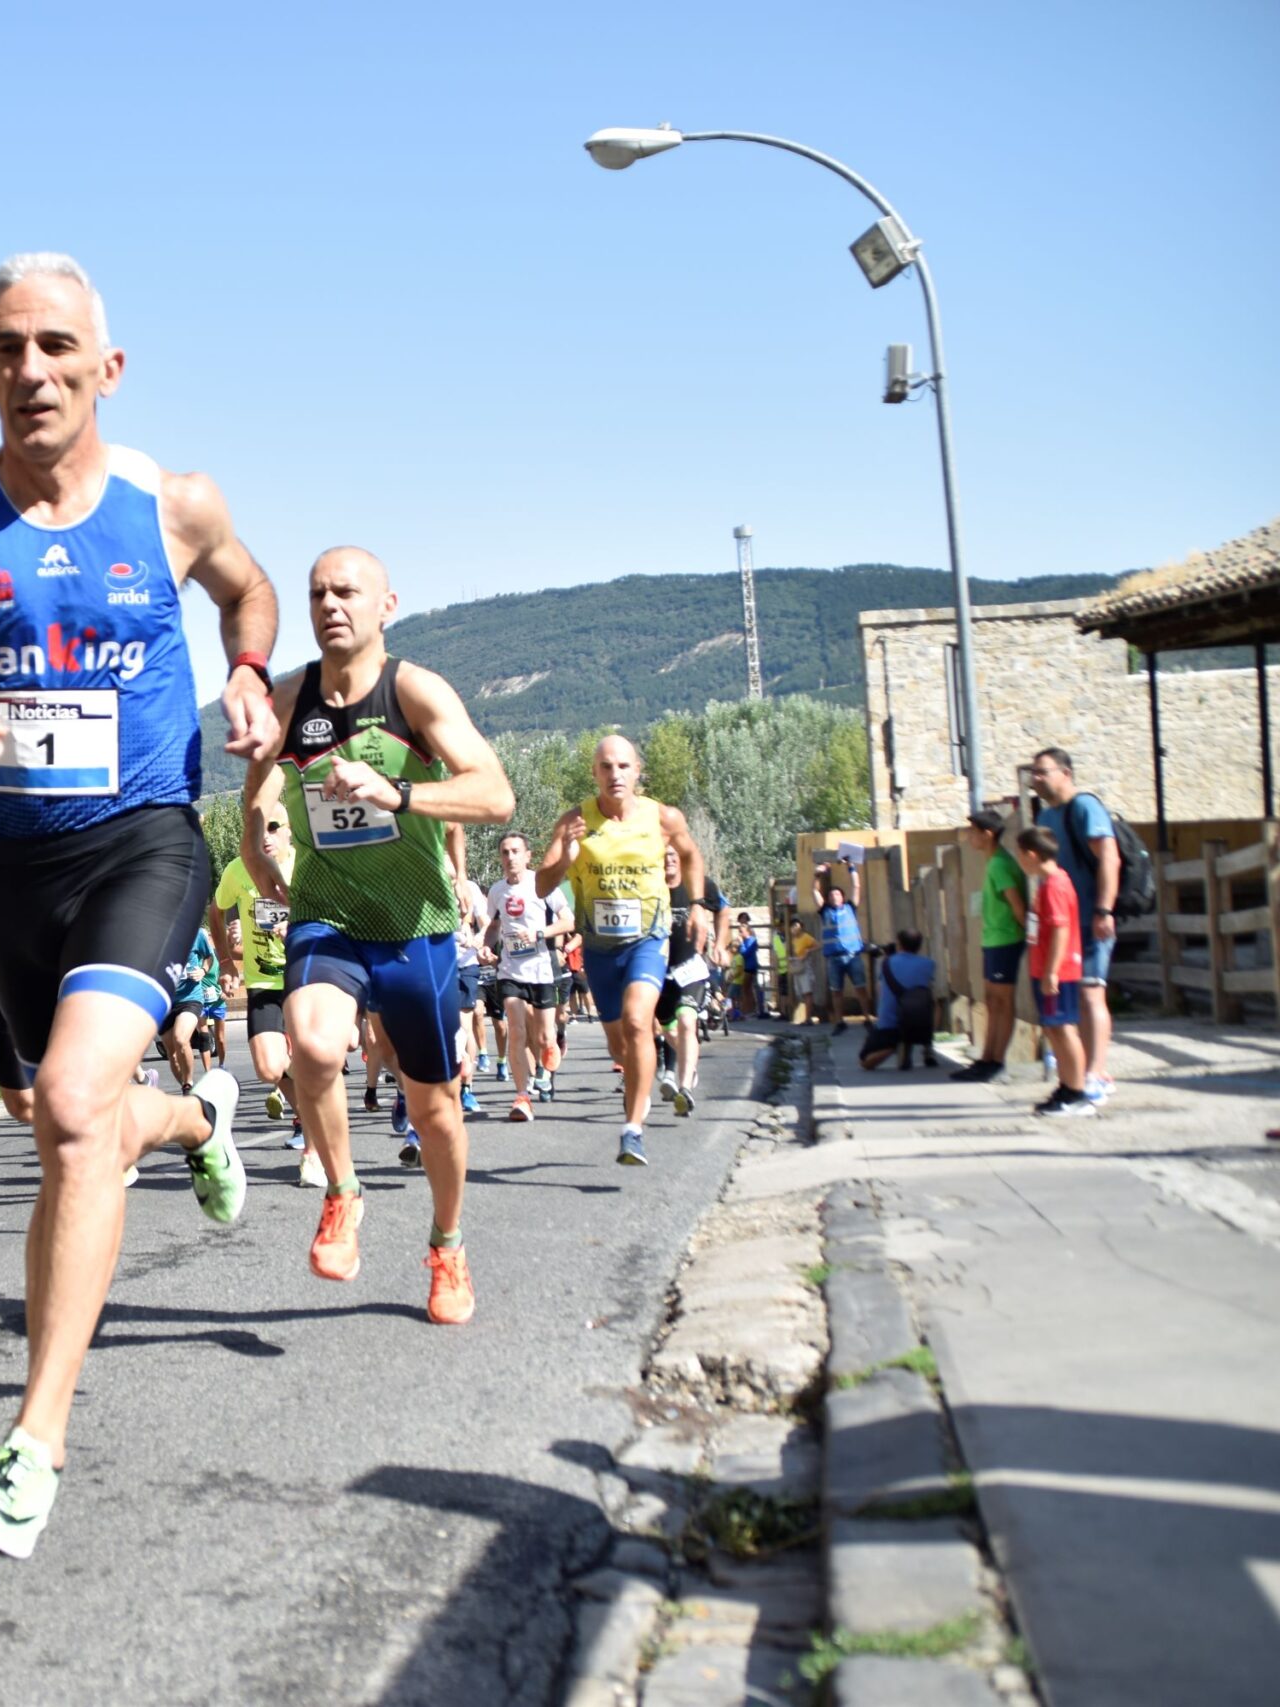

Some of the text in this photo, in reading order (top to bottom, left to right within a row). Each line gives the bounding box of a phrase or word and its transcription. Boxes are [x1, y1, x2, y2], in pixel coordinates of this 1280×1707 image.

[107, 589, 150, 605] ardoi
[10, 704, 80, 720] Noticias
[307, 722, 327, 732] KIA
[36, 733, 55, 765] 1
[332, 807, 369, 830] 52
[598, 878, 639, 892] GANA
[270, 911, 289, 923] 32
[602, 913, 630, 926] 107
